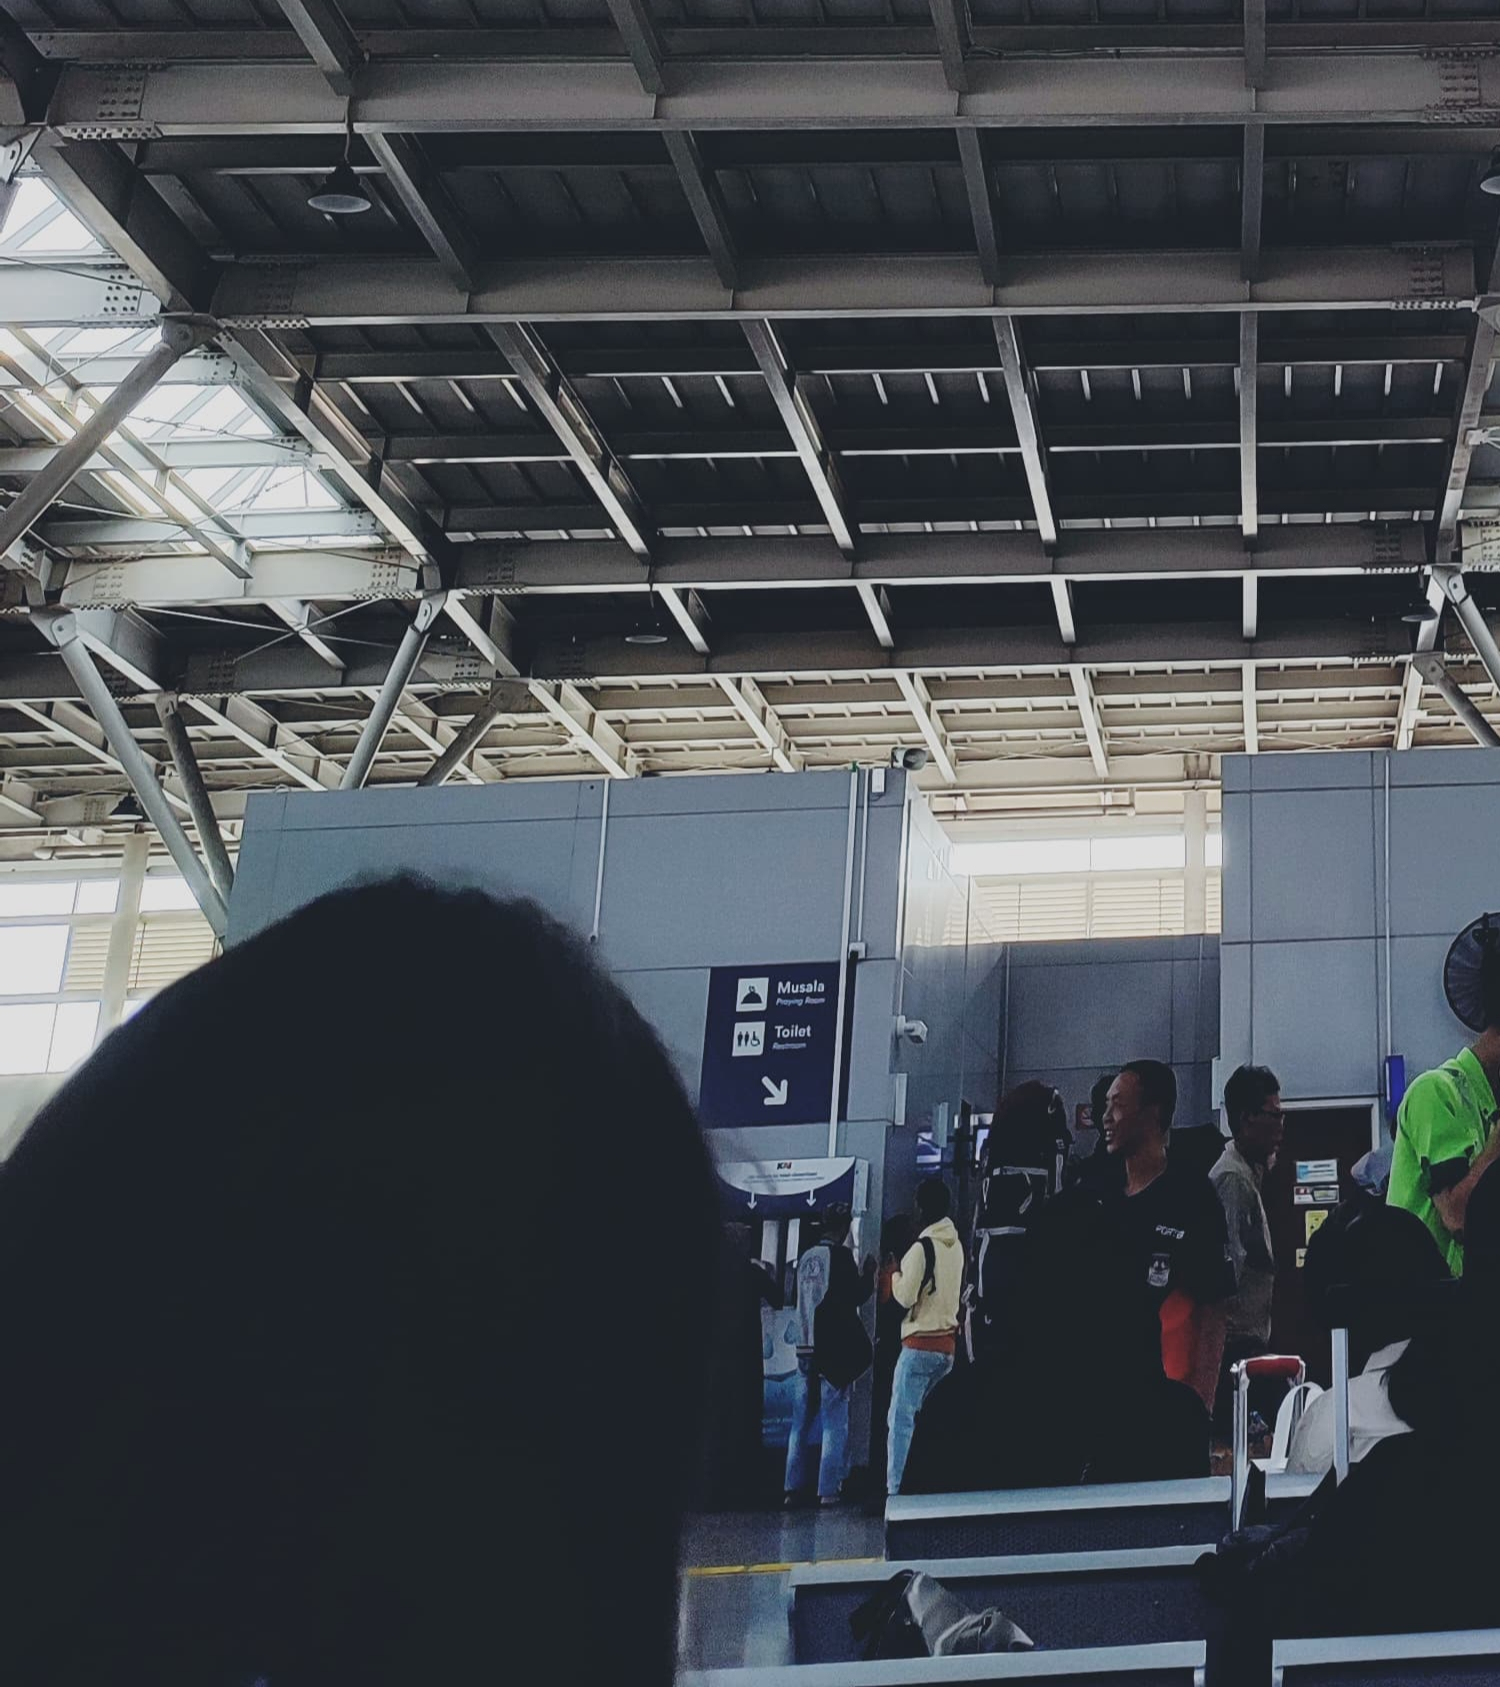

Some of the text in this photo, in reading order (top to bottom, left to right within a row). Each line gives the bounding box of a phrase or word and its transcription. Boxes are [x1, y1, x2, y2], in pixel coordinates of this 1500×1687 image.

[777, 979, 825, 995] Musala
[775, 996, 826, 1007] Praying Room
[774, 1024, 812, 1039] Toilet
[771, 1042, 807, 1051] Restroom
